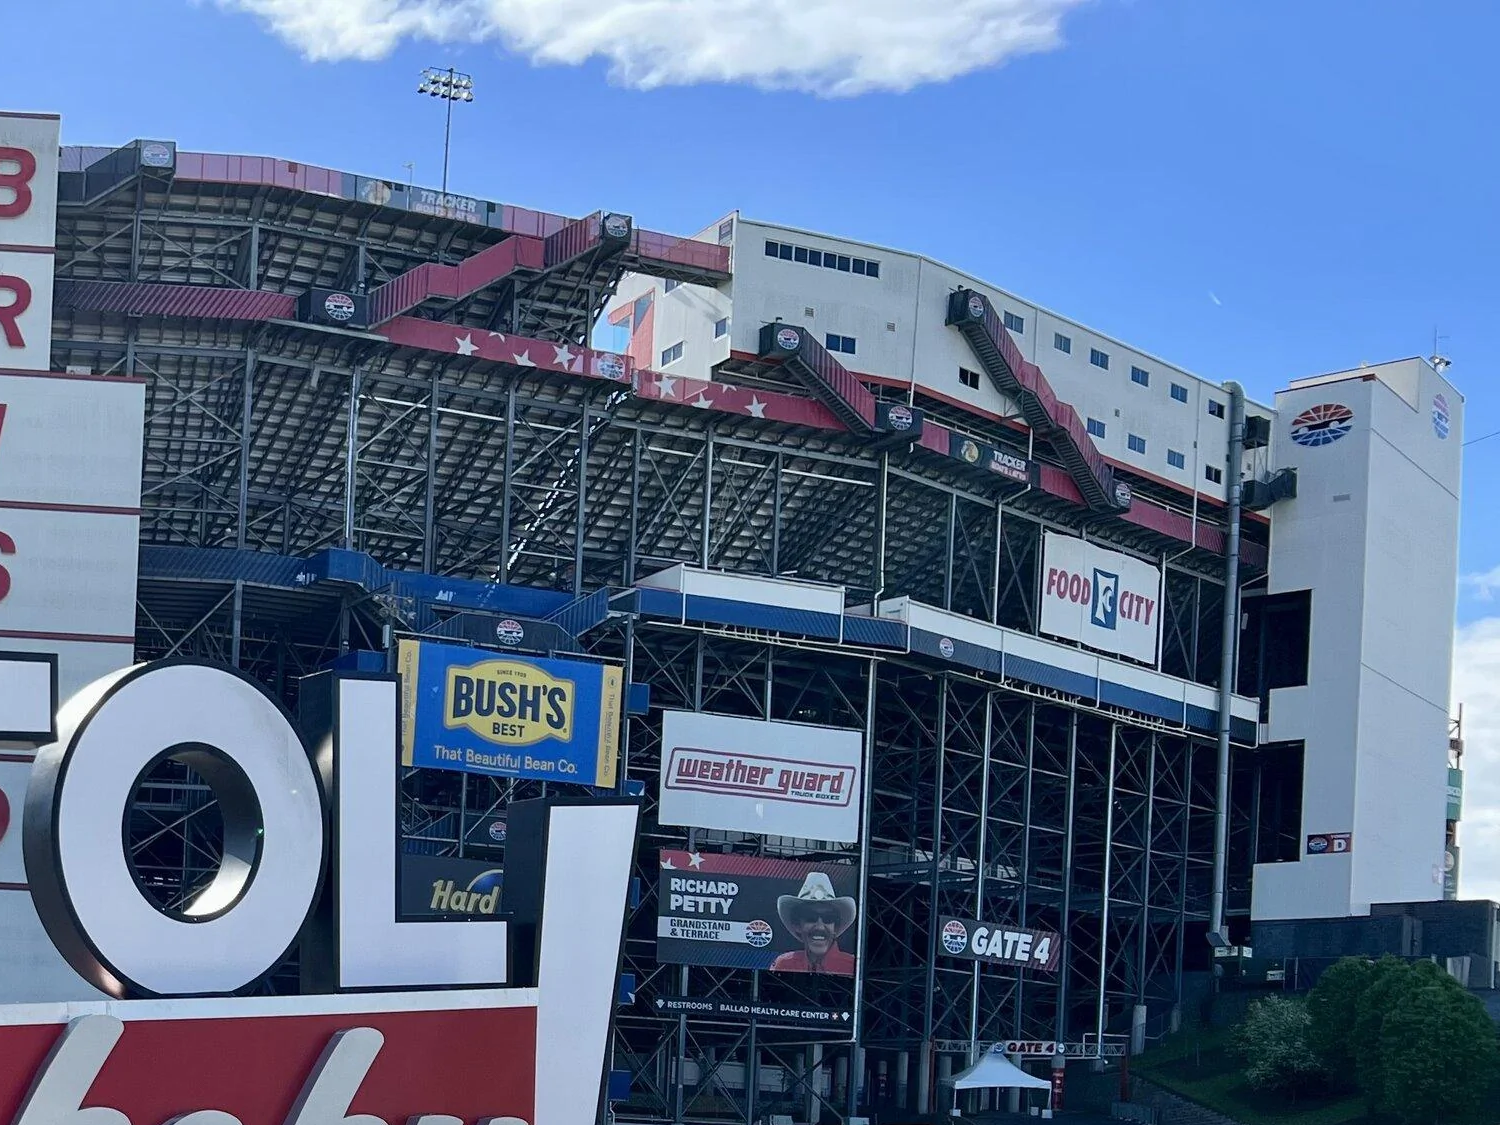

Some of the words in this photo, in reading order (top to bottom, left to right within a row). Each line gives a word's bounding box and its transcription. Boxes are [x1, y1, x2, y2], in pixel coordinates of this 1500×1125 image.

[420, 190, 477, 213] TRACKER
[993, 450, 1027, 472] TRACKER
[1046, 567, 1092, 606] FOOD
[1119, 590, 1155, 626] CITY
[452, 674, 567, 730] BUSH'S
[492, 722, 525, 738] BEST
[434, 744, 463, 762] That
[466, 749, 520, 768] Beautiful
[524, 755, 555, 772] Bean
[558, 759, 578, 774] Co.
[677, 757, 774, 786] weather
[777, 768, 845, 795] guard
[790, 790, 814, 798] TRUCK
[815, 793, 841, 801] BOXES
[1333, 838, 1348, 853] D
[429, 879, 500, 915] Hard
[669, 877, 739, 896] RICHARD
[669, 893, 734, 915] PETTY
[669, 918, 731, 932] GRANDSTAND
[669, 927, 679, 937] &
[680, 929, 721, 940] TERRACE
[971, 926, 1033, 962] GATE
[1033, 937, 1051, 965] 4
[667, 1000, 713, 1011] RESTROOMS
[719, 1003, 750, 1014] BALLAD
[750, 1006, 779, 1017] HEALTH
[780, 1008, 800, 1018] CARE
[801, 1010, 830, 1020] CENTER
[1007, 1042, 1043, 1054] GATE
[1045, 1042, 1055, 1054] 4
